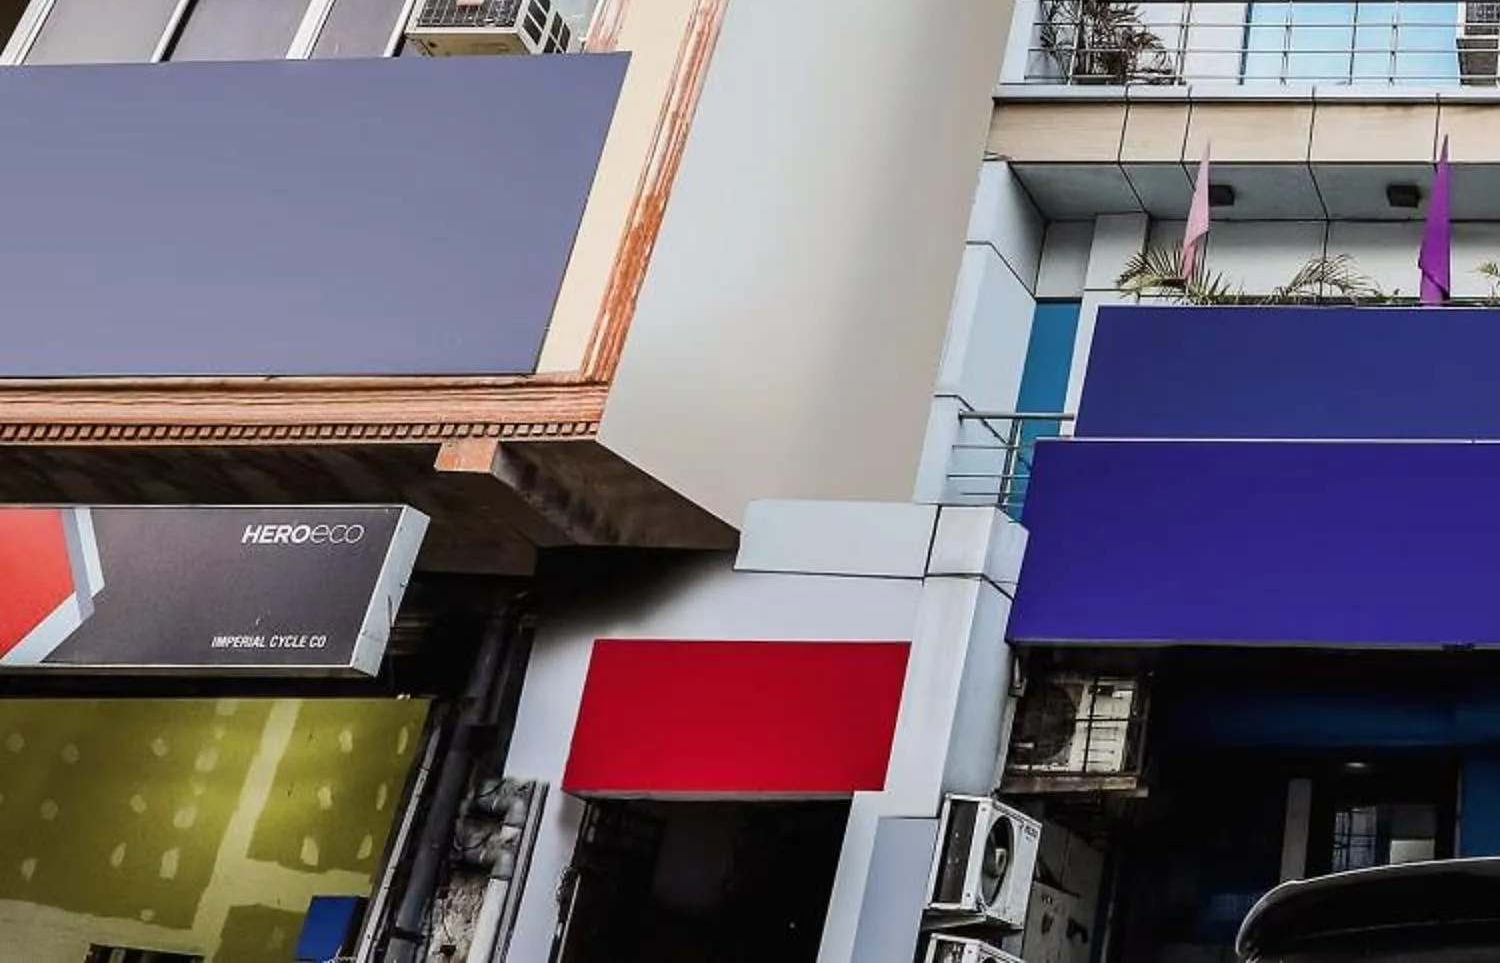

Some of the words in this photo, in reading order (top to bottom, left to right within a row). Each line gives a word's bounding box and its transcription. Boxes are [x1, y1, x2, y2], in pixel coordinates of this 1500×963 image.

[241, 524, 365, 544] HEROeco
[211, 635, 266, 648] IMPERIAL
[269, 635, 307, 648] CYCLE
[308, 635, 327, 648] CO
